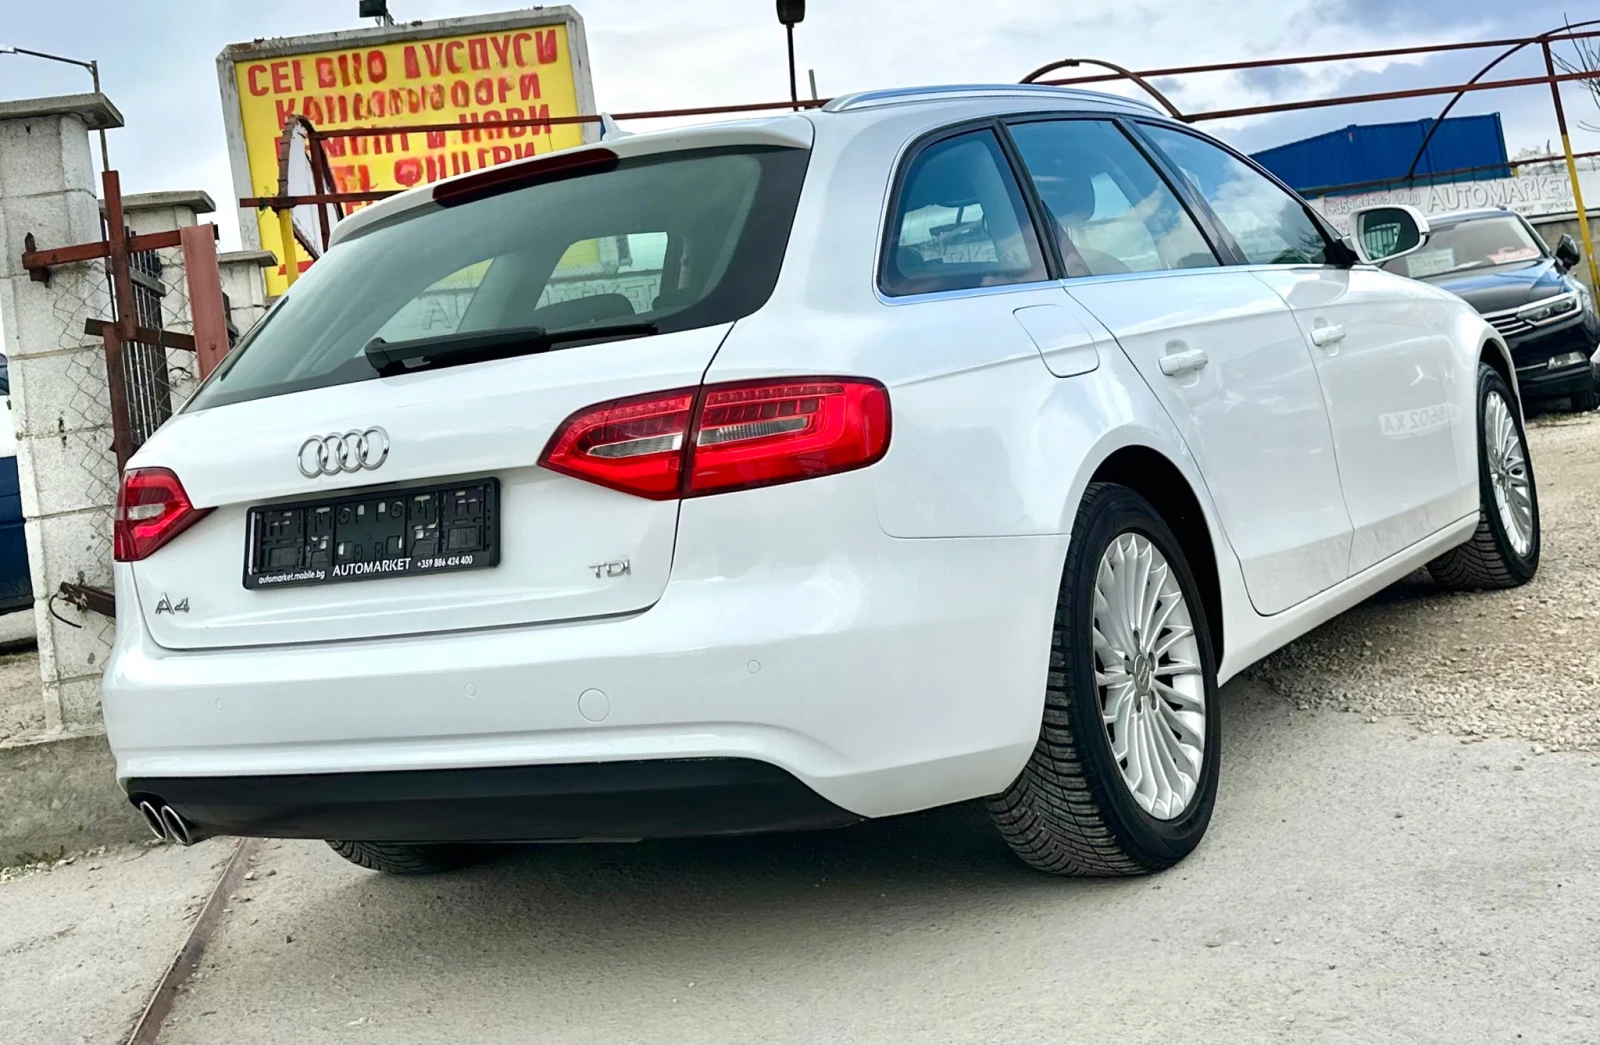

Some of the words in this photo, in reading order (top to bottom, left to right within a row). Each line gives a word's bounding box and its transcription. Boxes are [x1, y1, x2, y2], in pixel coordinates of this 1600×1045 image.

[459, 104, 551, 144] НОВИ
[1428, 174, 1570, 213] AUTOMARKET
[258, 569, 326, 584] automarket.mobile.bg
[332, 557, 412, 577] AUTOMARKET
[417, 559, 433, 569] +359
[433, 557, 447, 567] 886
[447, 555, 460, 567] 424
[460, 554, 474, 565] 400
[588, 559, 631, 579] TDI
[155, 592, 190, 615] A4
